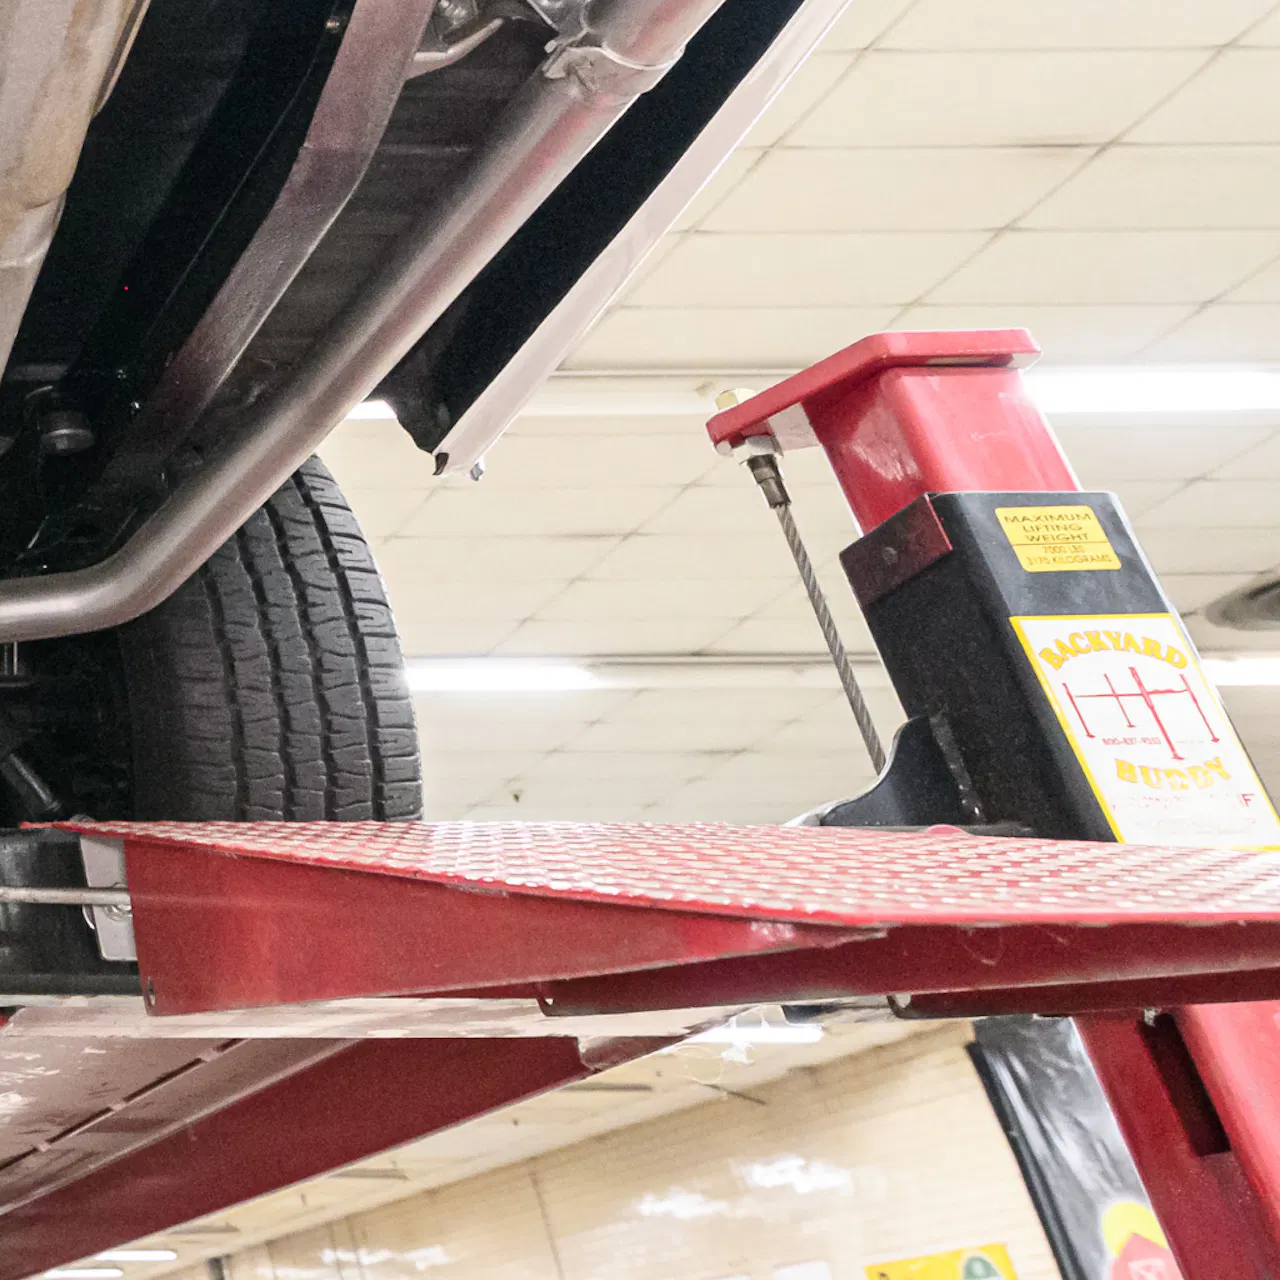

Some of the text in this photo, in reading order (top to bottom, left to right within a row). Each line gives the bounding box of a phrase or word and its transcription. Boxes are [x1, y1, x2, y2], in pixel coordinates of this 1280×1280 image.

[1004, 512, 1092, 524] MAXIMUM
[1022, 523, 1083, 533] LIFTING
[1025, 532, 1090, 543] WEIGHT
[1038, 629, 1189, 671] BACKYARD
[1114, 756, 1232, 791] BUDDY
